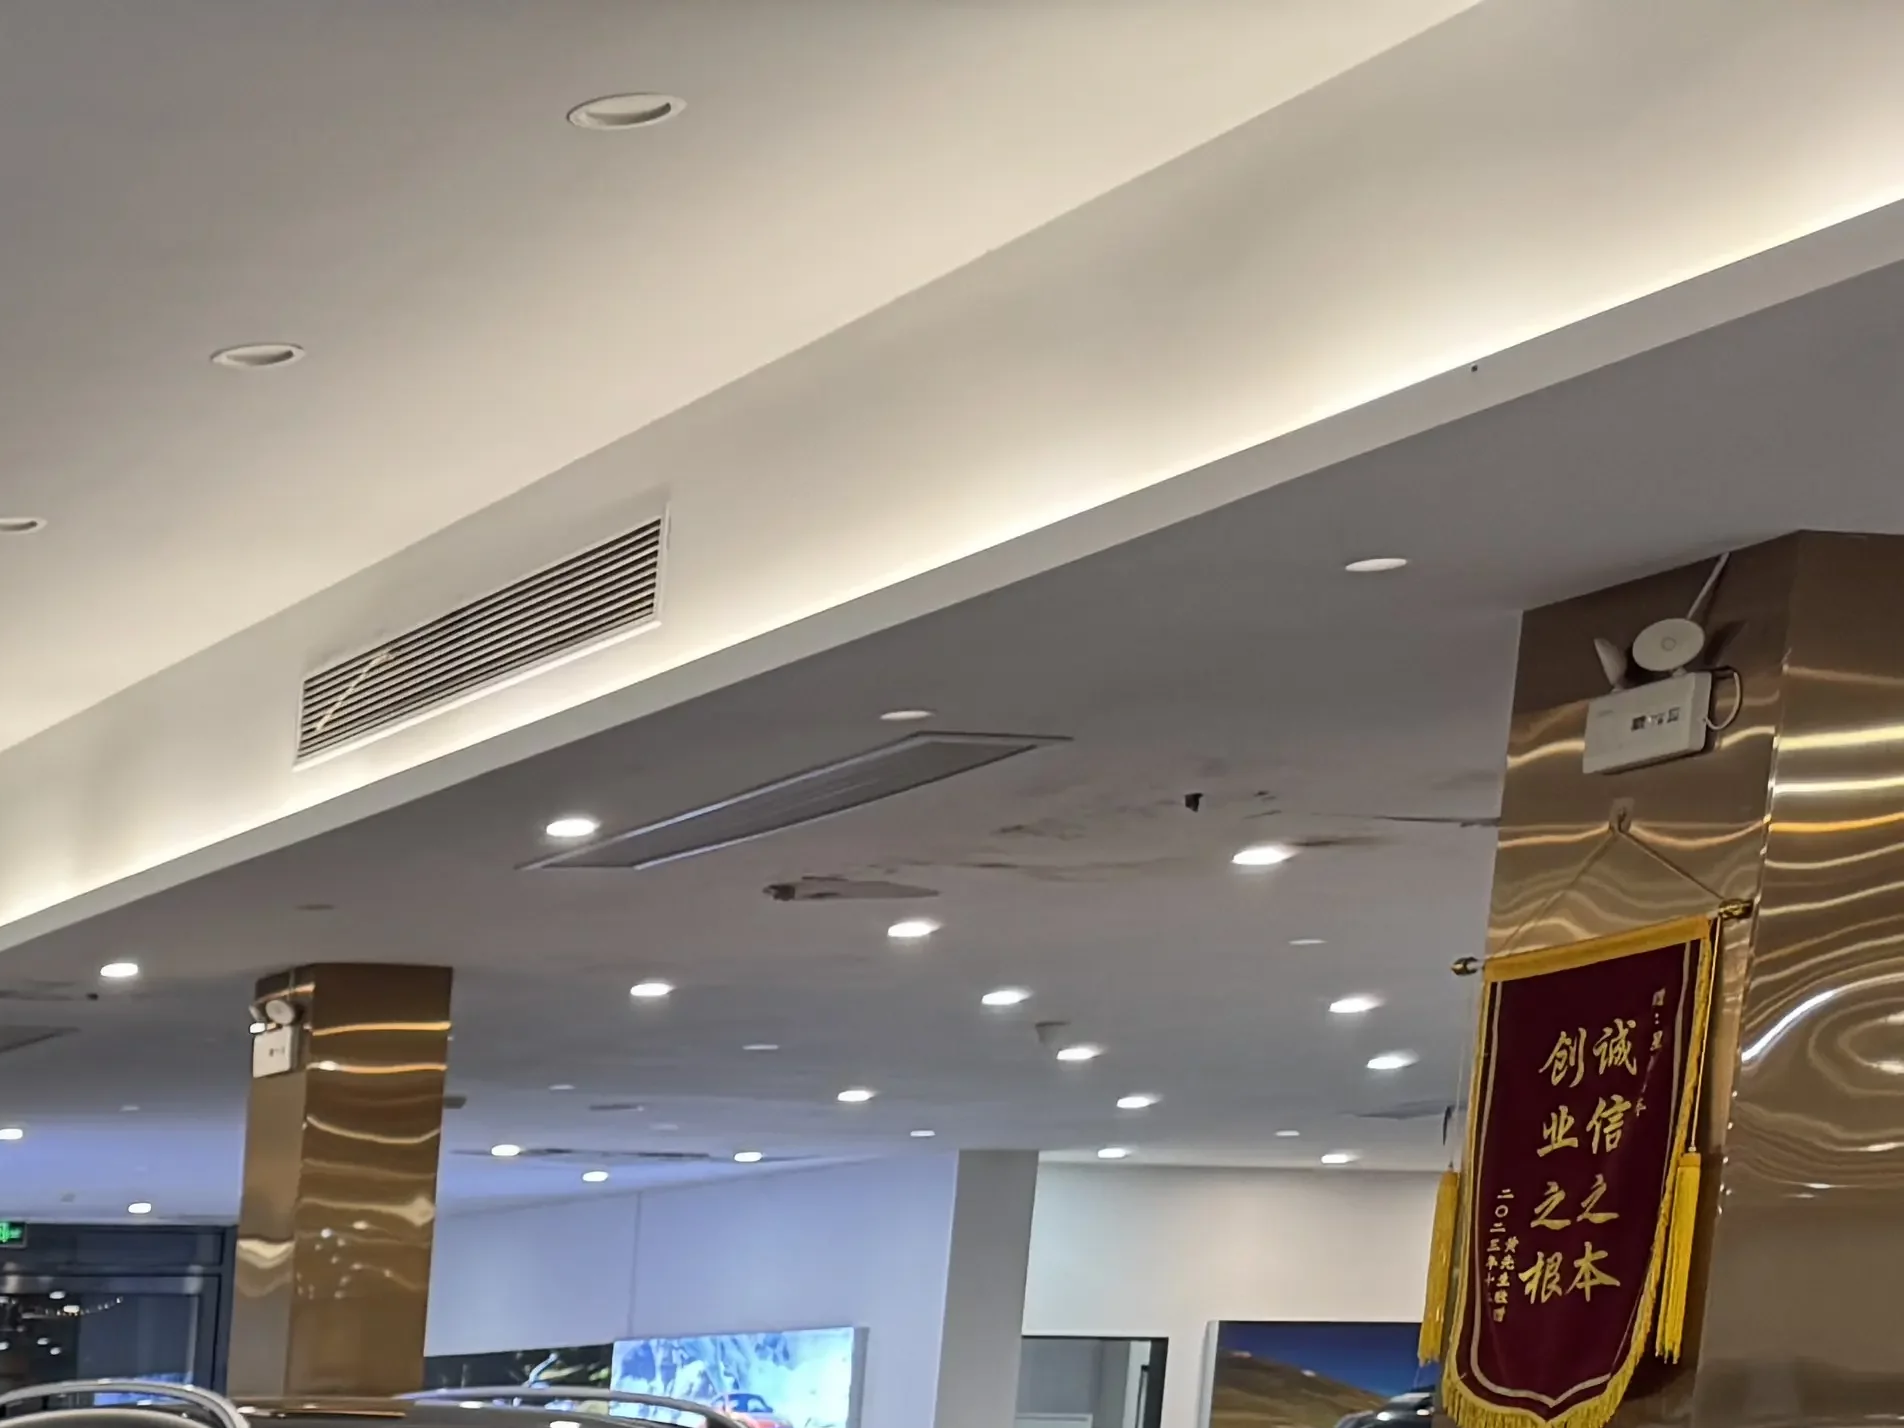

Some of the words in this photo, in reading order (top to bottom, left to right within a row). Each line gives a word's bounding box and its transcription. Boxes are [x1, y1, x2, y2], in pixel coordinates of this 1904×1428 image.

[1518, 1027, 1587, 1304] 创业之根
[1565, 1018, 1637, 1303] 诚信之本
